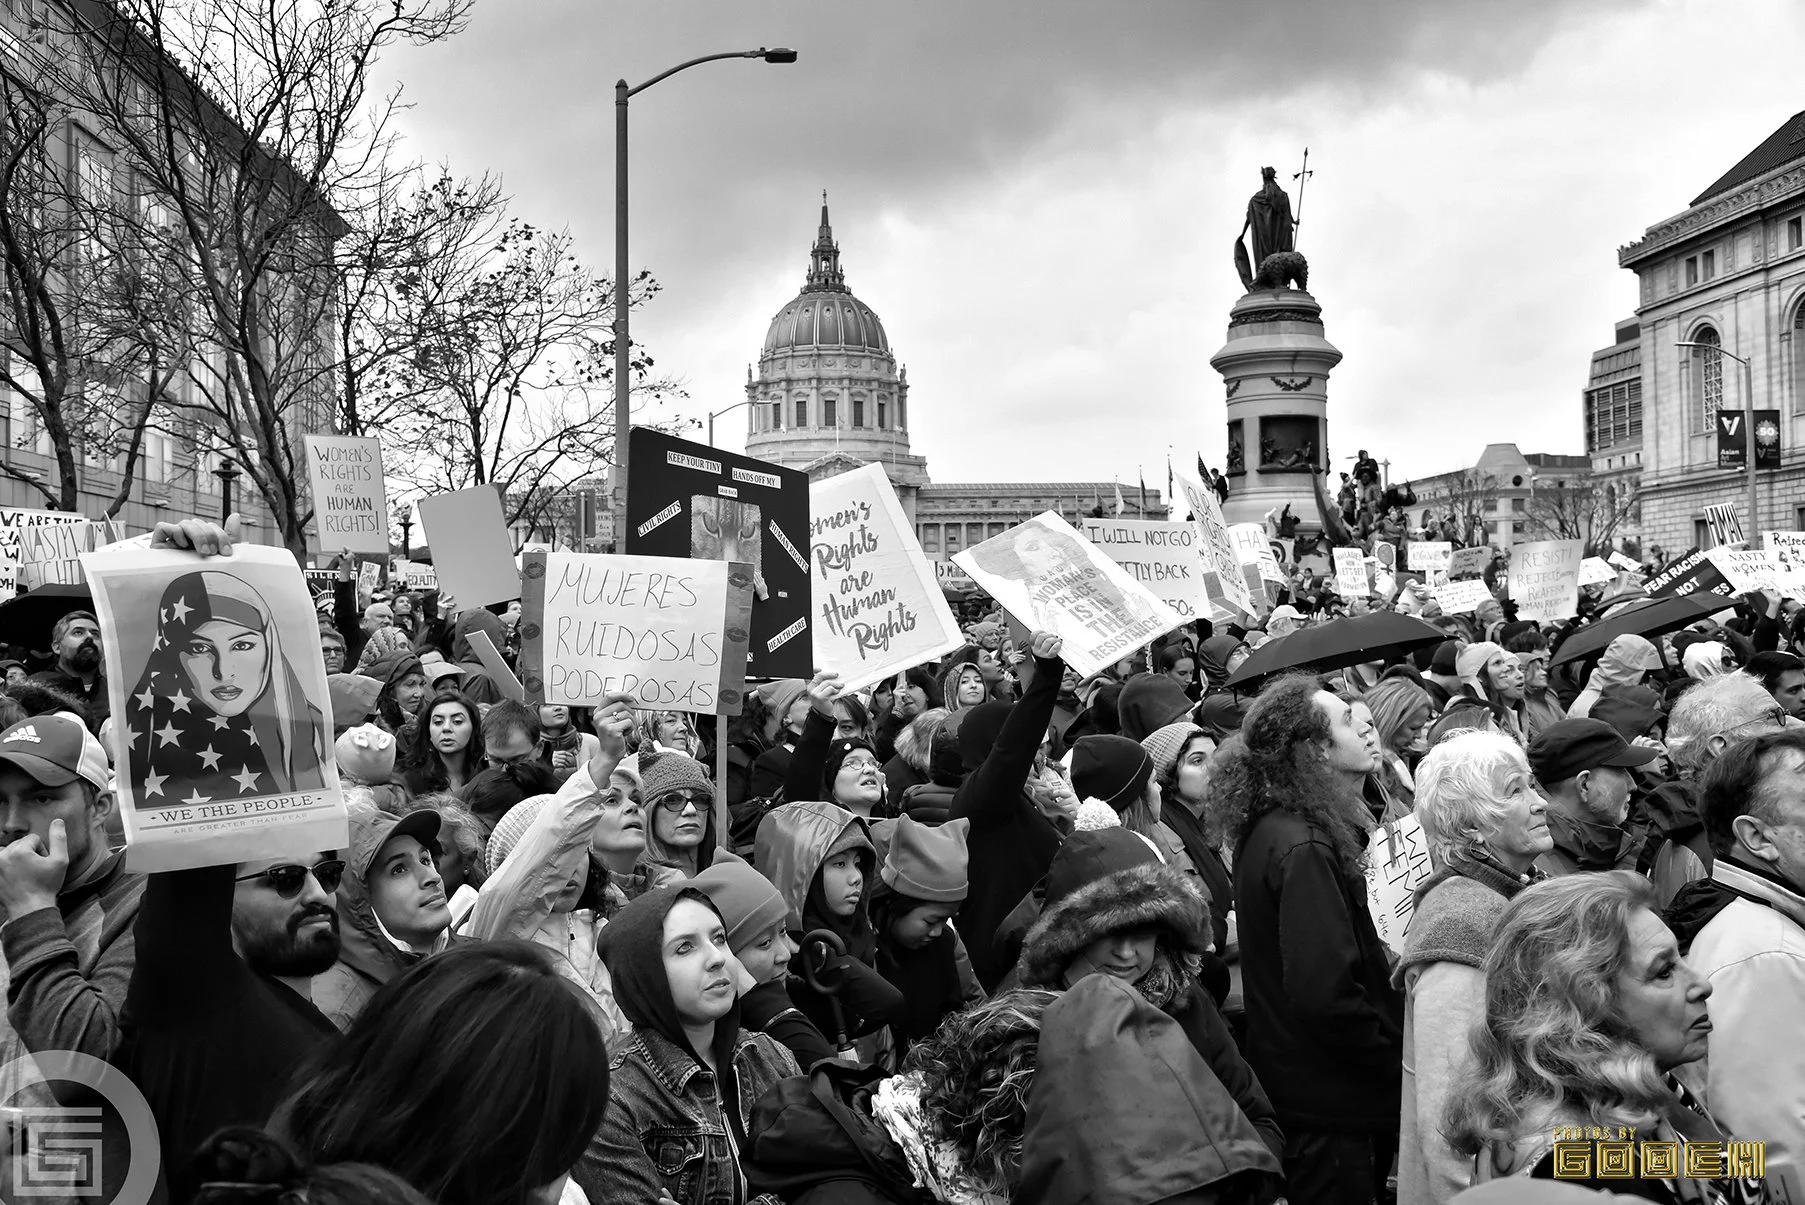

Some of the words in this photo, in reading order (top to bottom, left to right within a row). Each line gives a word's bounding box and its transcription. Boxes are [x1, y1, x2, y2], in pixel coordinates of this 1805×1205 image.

[1760, 426, 1775, 436] 50
[314, 445, 373, 463] WOMEN'S
[668, 451, 686, 465] KEEP
[686, 456, 706, 469] YOUR
[706, 460, 721, 472] TINY
[320, 464, 371, 481] RIGHTS
[733, 470, 754, 482] HANDS
[754, 474, 766, 485] OFF
[766, 478, 776, 486] MY
[335, 484, 355, 494] ARE
[327, 496, 373, 511] HUMAN
[0, 511, 24, 527] WE
[326, 511, 380, 535] RIGHTS!
[638, 518, 656, 536] CIVIL
[656, 501, 681, 524] RIGHTS
[769, 520, 789, 548] HUMAN
[788, 545, 808, 572] RIGHTS
[1087, 526, 1101, 543] I
[1103, 528, 1141, 543] WILL
[1145, 530, 1168, 546] NOT
[1169, 530, 1191, 546] GO
[811, 524, 879, 580] Rights
[1729, 552, 1767, 562] NASTY
[840, 570, 873, 595] are
[1155, 562, 1190, 580] BACK
[1643, 571, 1672, 595] FEAR
[548, 562, 698, 609] MUJERES
[1033, 567, 1097, 604] WOMAN'S
[1055, 582, 1098, 608] PLACE
[1675, 576, 1700, 596] NOT
[822, 587, 897, 637] Human
[1068, 603, 1093, 622] IS
[1087, 592, 1114, 613] IN
[768, 629, 791, 651] HEALTH
[791, 619, 806, 638] CARE
[847, 602, 917, 661] Rights
[1085, 607, 1135, 639] THE
[556, 615, 719, 666] RUIDOSAS
[1088, 615, 1163, 662] RESISTANCE
[550, 664, 714, 707] PODEROSAS
[159, 808, 194, 823] WE
[197, 803, 238, 818] THE
[243, 795, 313, 813] PEOPLE
[173, 827, 194, 835] ARE
[199, 820, 247, 832] GREATER
[250, 816, 278, 826] THAN
[282, 813, 308, 822] FEAR
